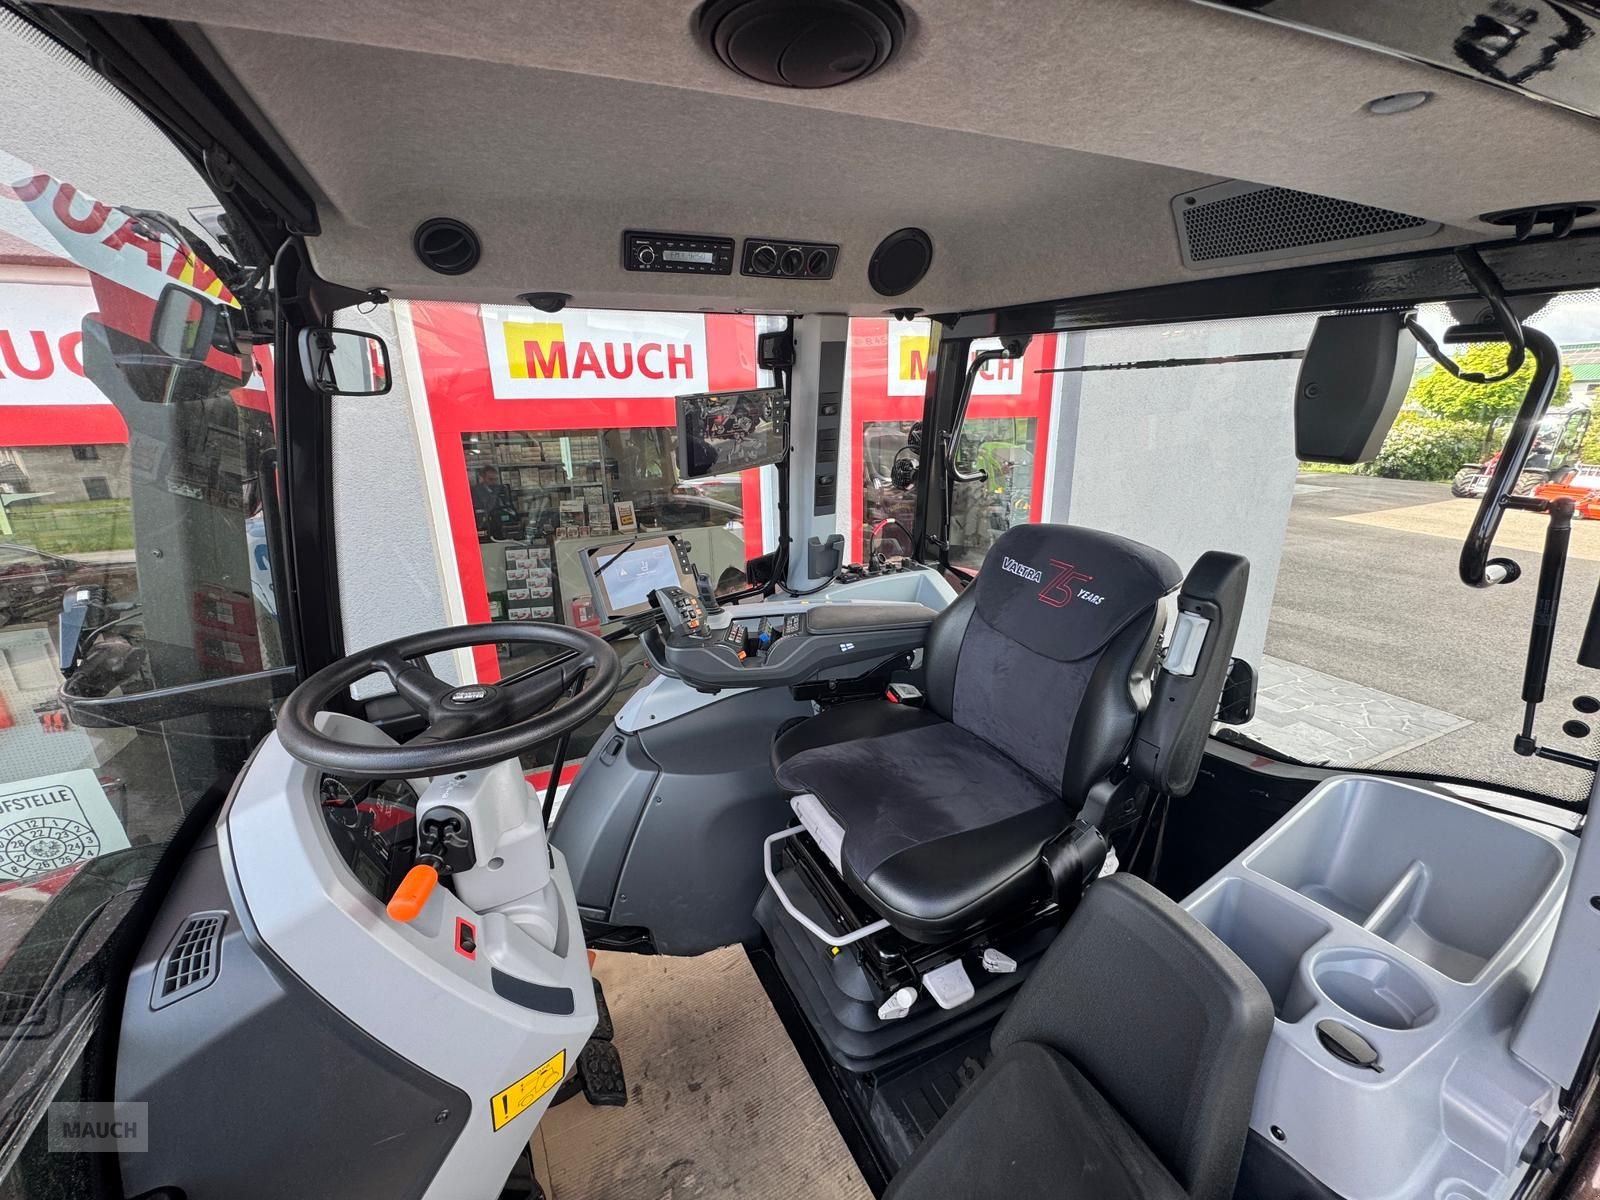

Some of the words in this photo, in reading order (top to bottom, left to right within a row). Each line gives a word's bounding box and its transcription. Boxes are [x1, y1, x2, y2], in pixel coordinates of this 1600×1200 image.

[523, 340, 694, 380] MAUCH
[1002, 556, 1043, 583] VALTRA
[1038, 558, 1094, 608] 75
[1077, 588, 1105, 605] YEARS
[25, 820, 39, 828] 12
[4, 828, 15, 837] 11
[30, 829, 45, 838] 22
[74, 825, 81, 833] 2
[55, 830, 70, 839] 23
[11, 840, 25, 849] 28
[86, 836, 94, 844] 3
[67, 843, 81, 851] 24
[87, 849, 94, 857] 4
[14, 854, 26, 863] 27
[60, 855, 73, 865] 25
[10, 865, 19, 874] 8
[35, 860, 50, 870] 26
